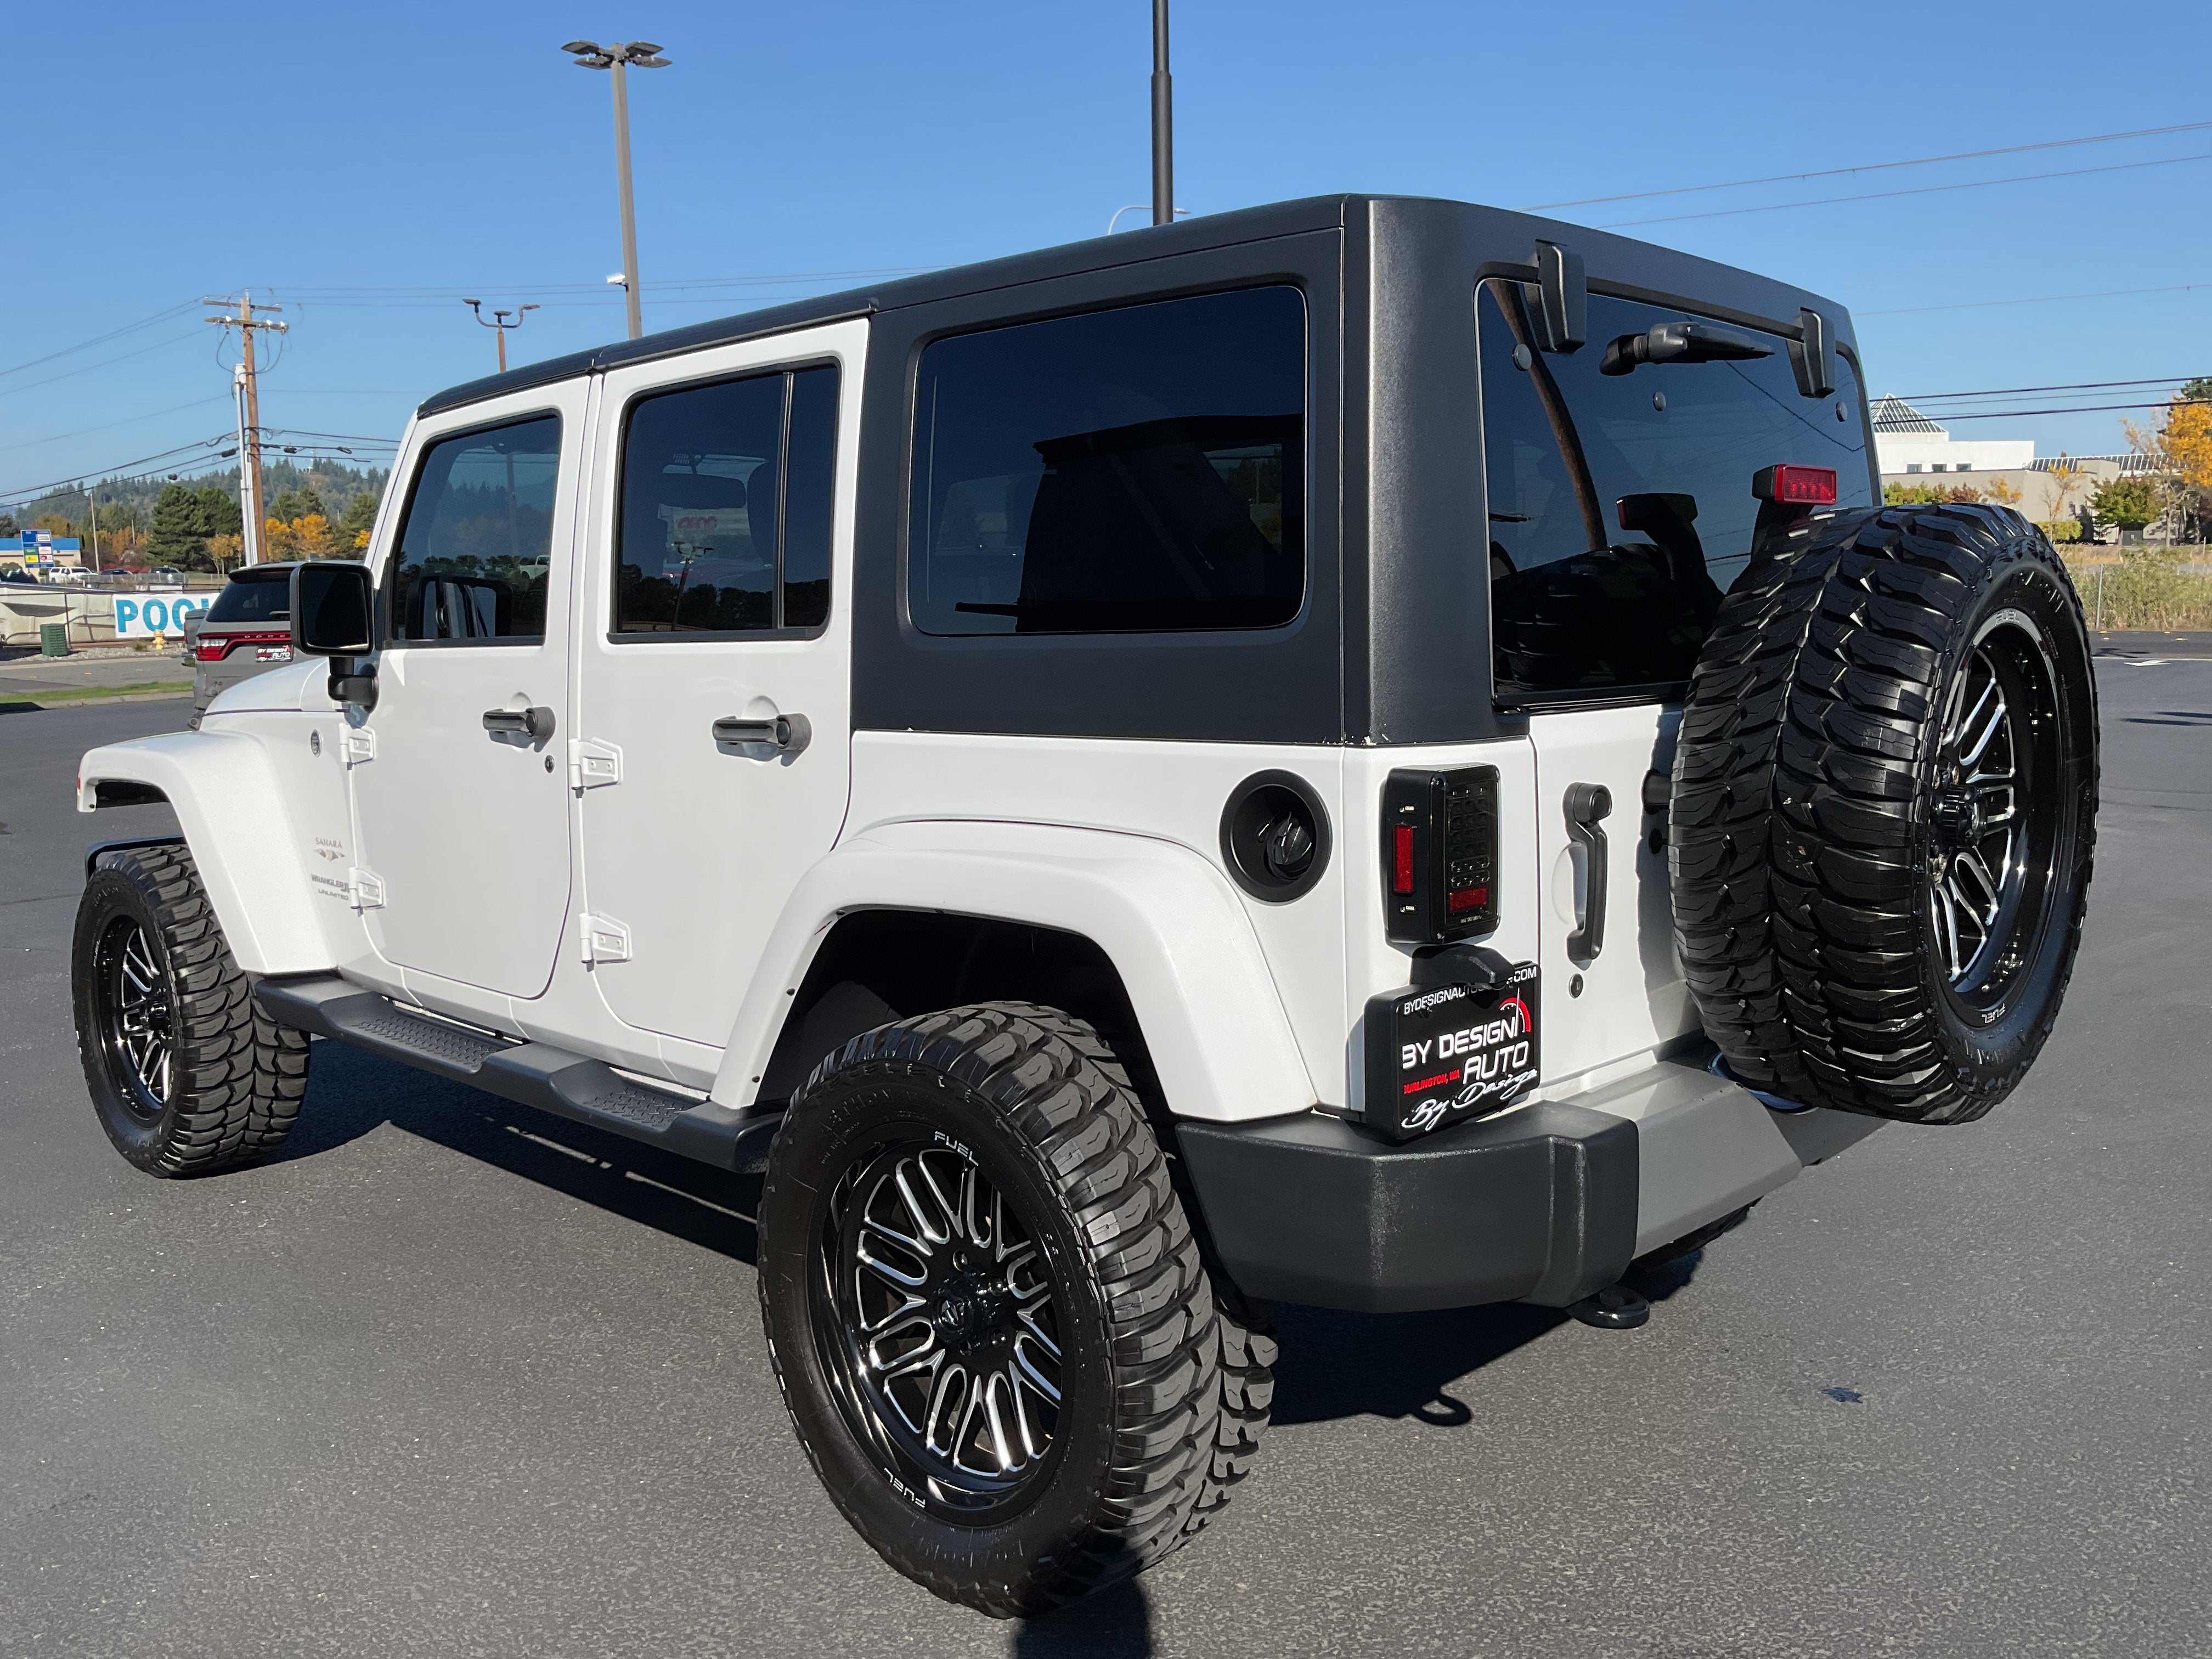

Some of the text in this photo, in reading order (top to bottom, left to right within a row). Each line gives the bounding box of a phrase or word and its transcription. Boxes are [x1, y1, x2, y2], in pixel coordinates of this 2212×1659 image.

[1996, 610, 2019, 624] FUEL
[315, 837, 342, 848] SAHARA
[311, 873, 343, 888] WRANGLER
[318, 888, 349, 900] UNLIMITED
[1982, 1003, 2005, 1023] FUEL
[1402, 1016, 1516, 1069] BY DESIGN
[1463, 1041, 1530, 1085] AUTO
[1449, 1069, 1460, 1080] WA
[1401, 1069, 1538, 1131] By Design
[934, 1131, 979, 1166] FUEL
[884, 1468, 926, 1509] FUEL
